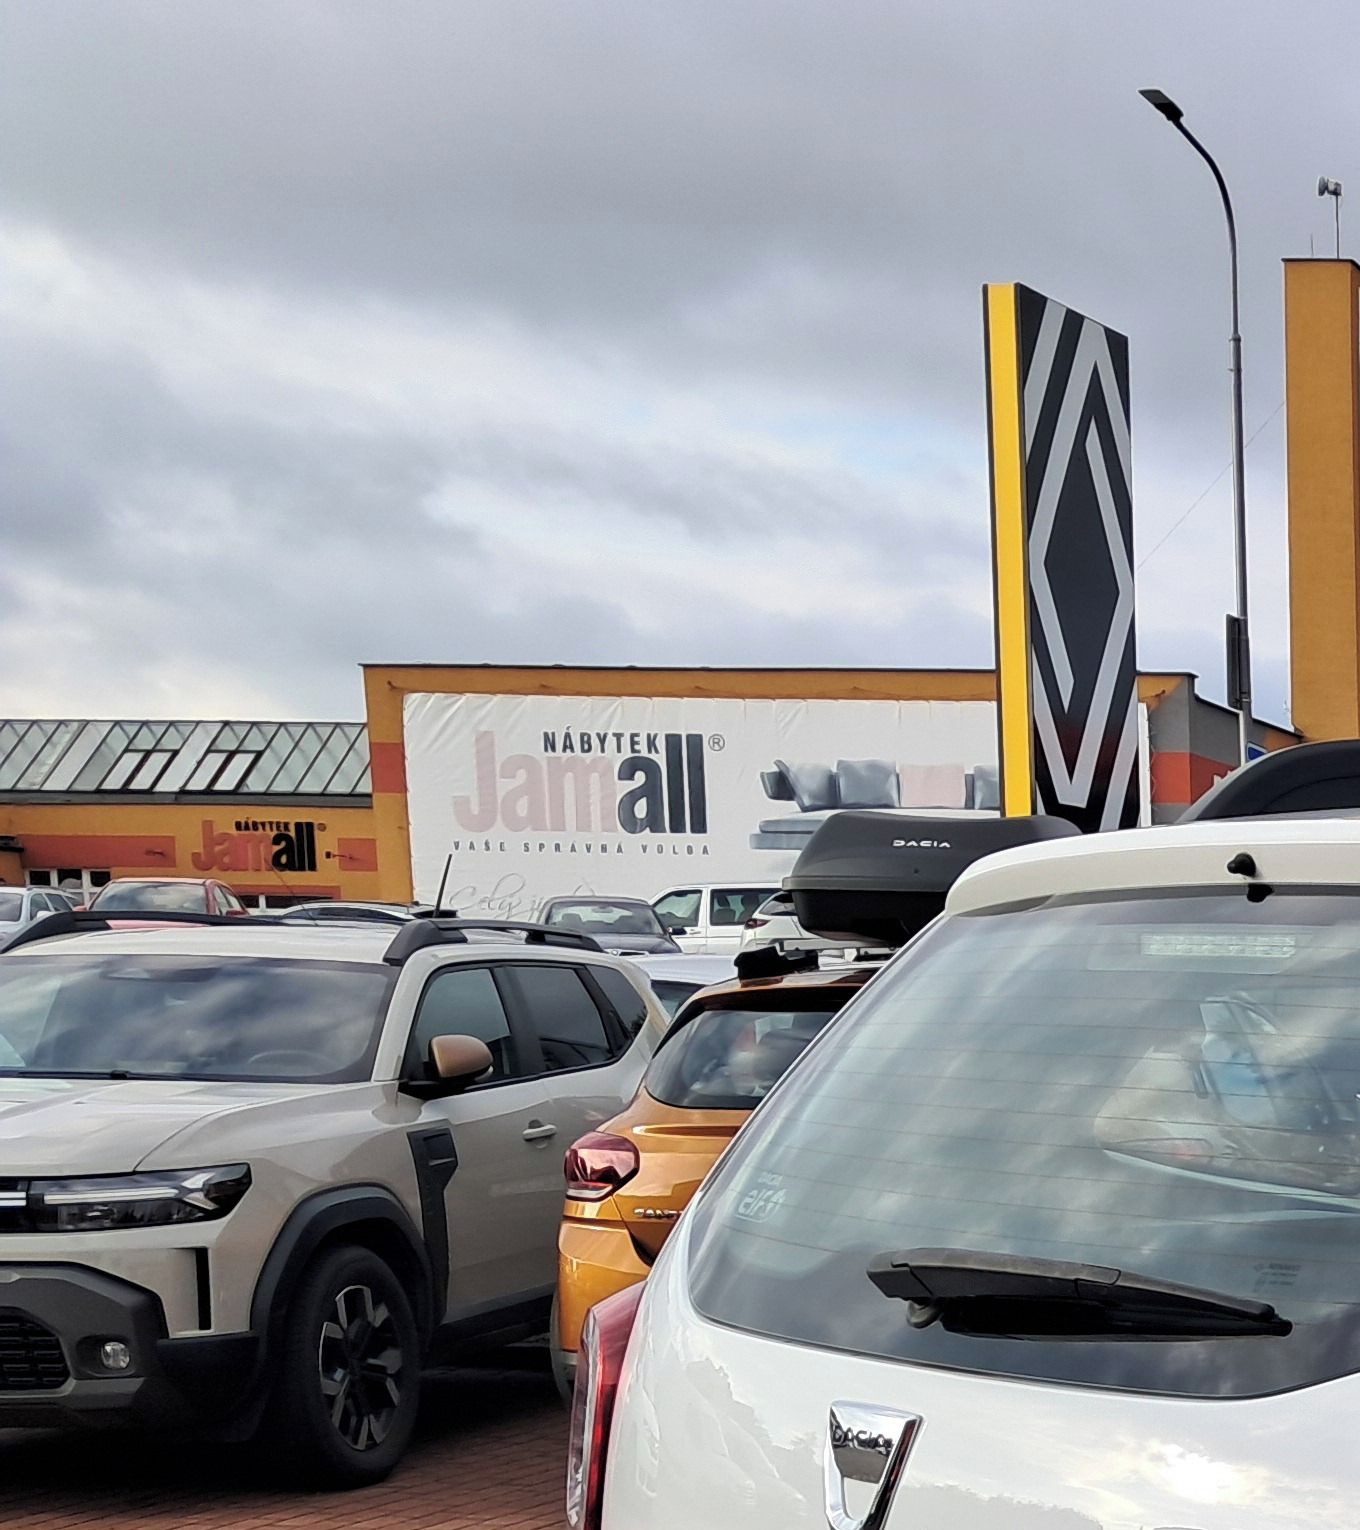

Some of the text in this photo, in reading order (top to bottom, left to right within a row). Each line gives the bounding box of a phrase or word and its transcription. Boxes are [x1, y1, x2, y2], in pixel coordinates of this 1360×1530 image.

[543, 726, 660, 754] NÁBYTEK
[452, 730, 708, 835] Jamall
[191, 820, 317, 872] Jamall
[892, 839, 951, 848] DACIA
